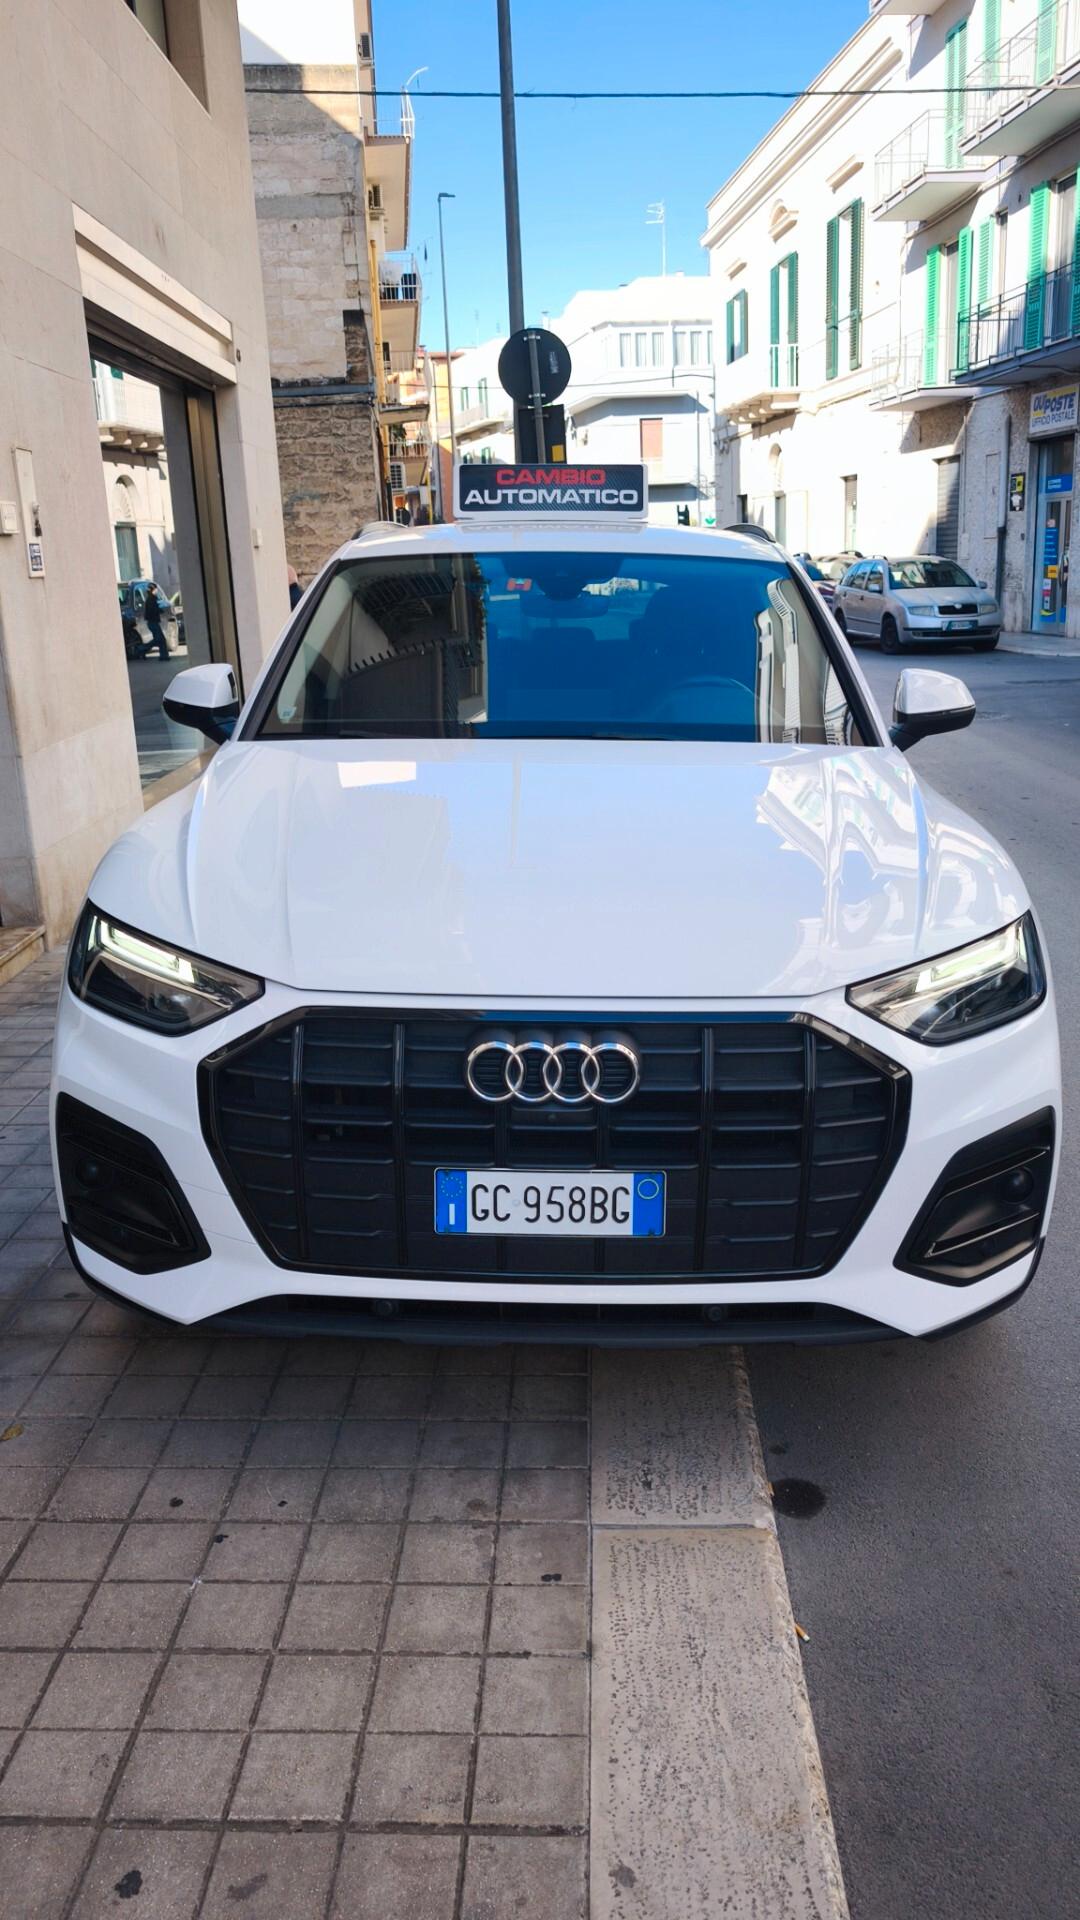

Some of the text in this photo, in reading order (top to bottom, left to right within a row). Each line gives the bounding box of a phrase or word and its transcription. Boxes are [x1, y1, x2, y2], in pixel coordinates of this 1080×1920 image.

[1051, 408, 1076, 424] POSTALE
[496, 469, 606, 485] CAMBIO
[464, 489, 639, 505] AUTOMATICO
[471, 1184, 630, 1224] GC 958BG
